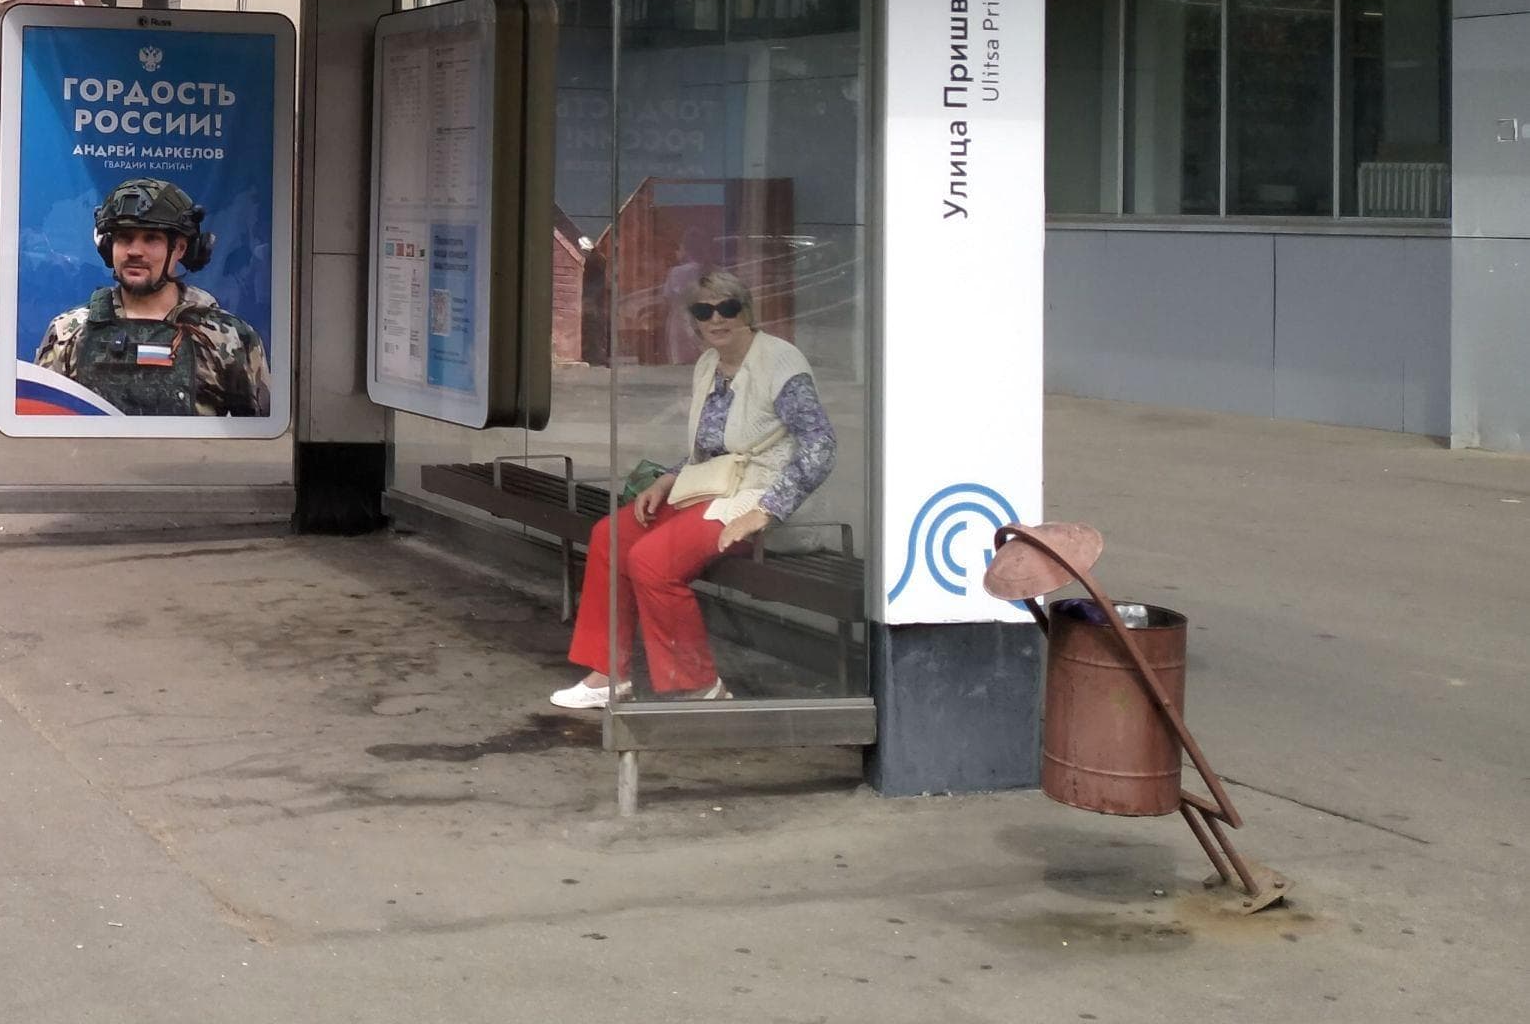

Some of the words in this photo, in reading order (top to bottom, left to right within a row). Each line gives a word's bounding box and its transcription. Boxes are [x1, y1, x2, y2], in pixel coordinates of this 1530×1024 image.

[982, 39, 1000, 102] Ulitsa
[63, 77, 236, 106] ГОРДОСТЬ
[74, 109, 223, 137] РОССИИ!
[72, 142, 137, 158] АНДРЕЙ
[141, 147, 225, 160] МАРКЕЛОВ
[104, 160, 147, 170] ГВАРДИИ
[149, 162, 193, 171] КАПИТАН
[943, 120, 971, 219] Улица
